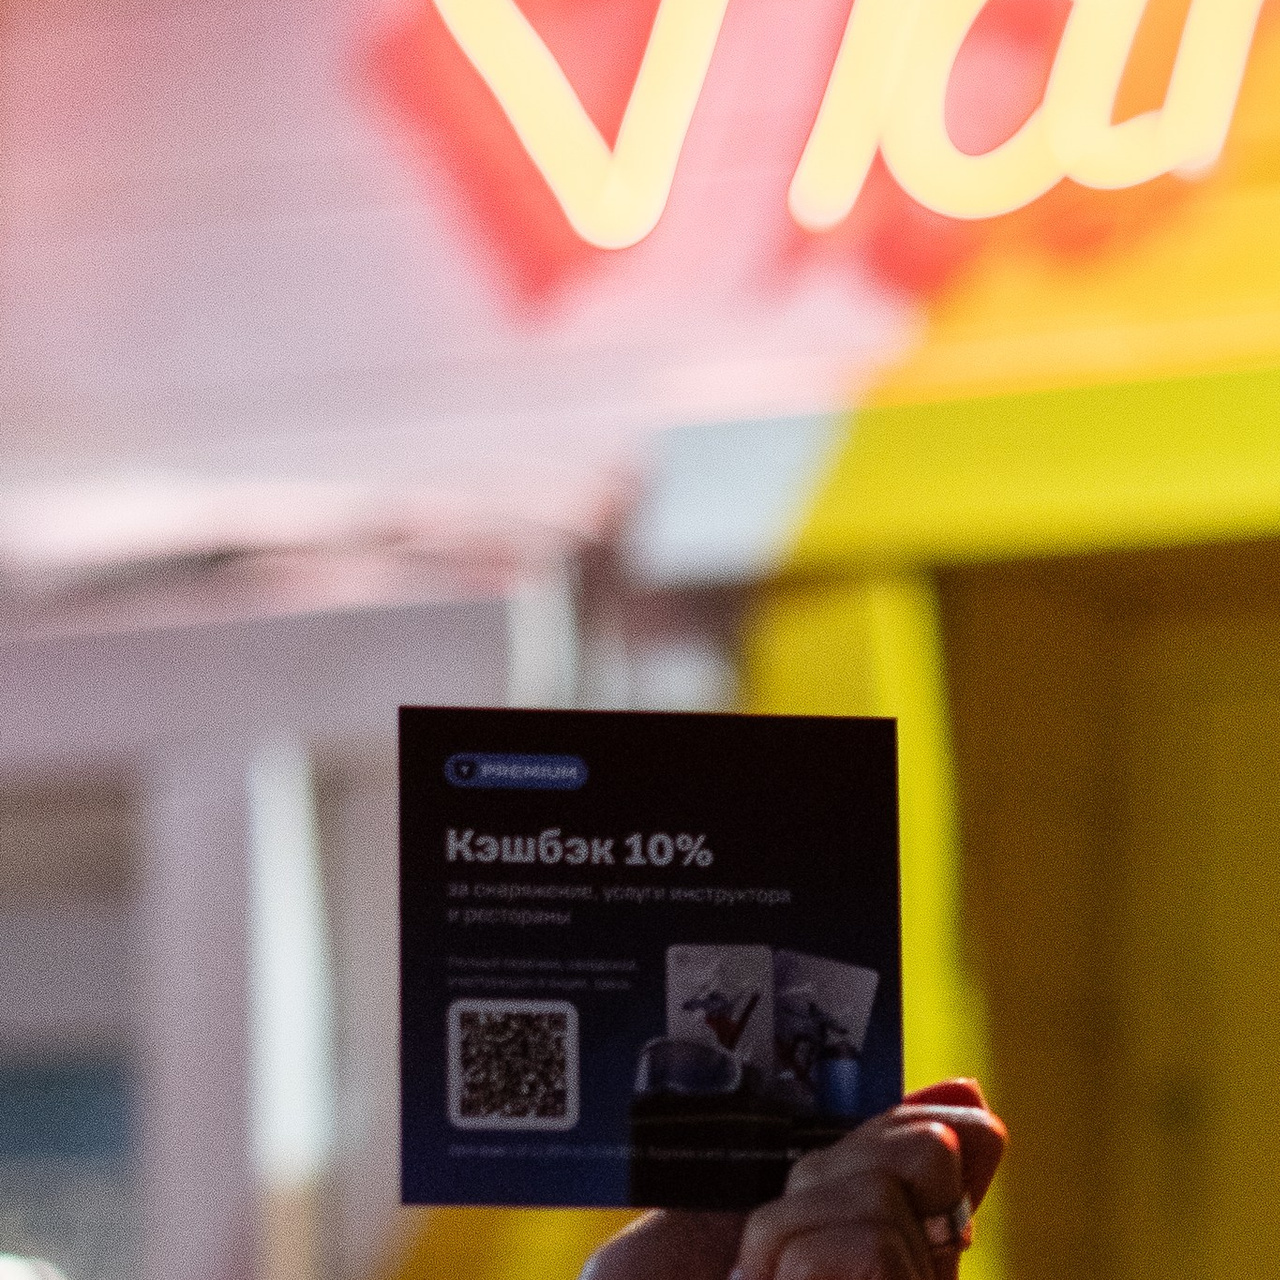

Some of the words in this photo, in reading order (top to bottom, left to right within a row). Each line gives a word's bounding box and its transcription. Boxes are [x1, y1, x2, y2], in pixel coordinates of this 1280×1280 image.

[481, 764, 577, 781] PREMIUM
[446, 827, 615, 865] Кэшбэк
[625, 832, 714, 867] 10%
[446, 884, 469, 898] за
[602, 886, 666, 904] услуги
[670, 887, 791, 907] инструктора
[446, 909, 460, 924] и
[463, 909, 573, 928] рестораны
